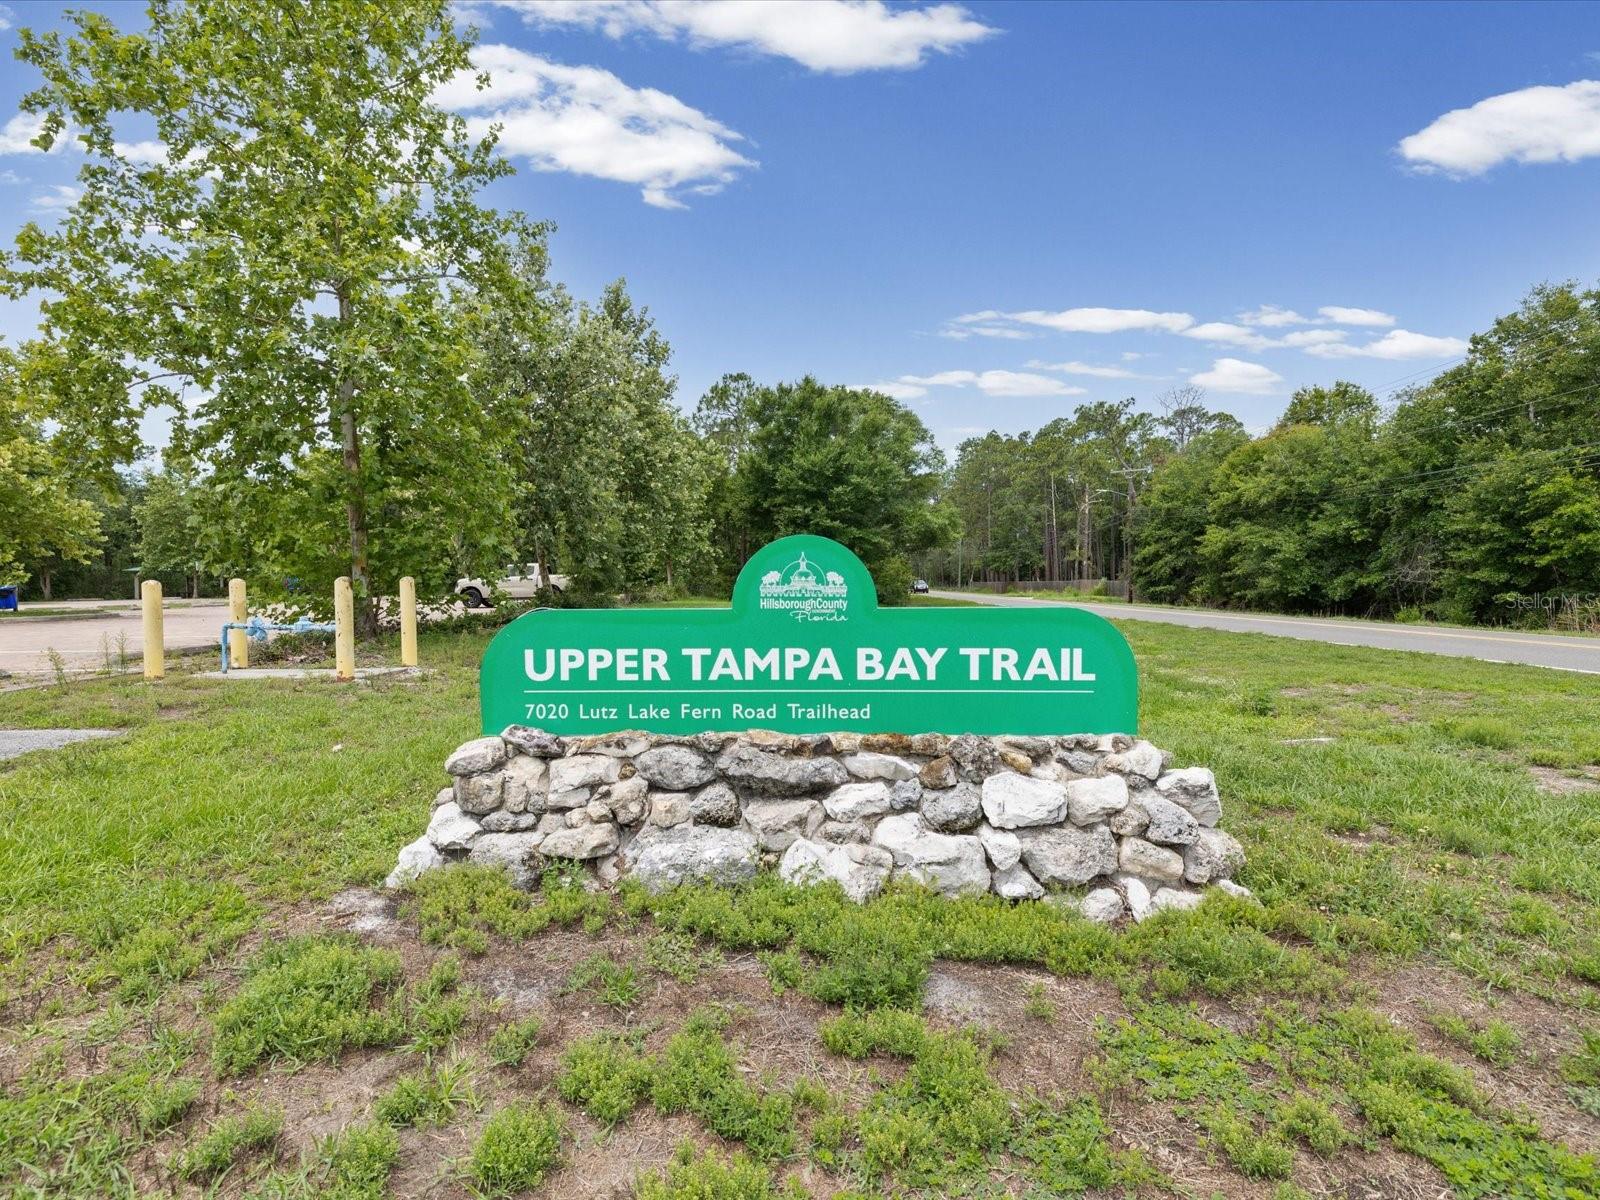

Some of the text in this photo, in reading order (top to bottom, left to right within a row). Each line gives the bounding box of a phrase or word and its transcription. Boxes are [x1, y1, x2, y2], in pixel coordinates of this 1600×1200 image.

[790, 610, 848, 623] Florida
[524, 648, 1096, 682] UPPER TAMPA BAY TRAIL
[524, 703, 871, 719] 7020 Lutz Lake Fern Road Trailhead
